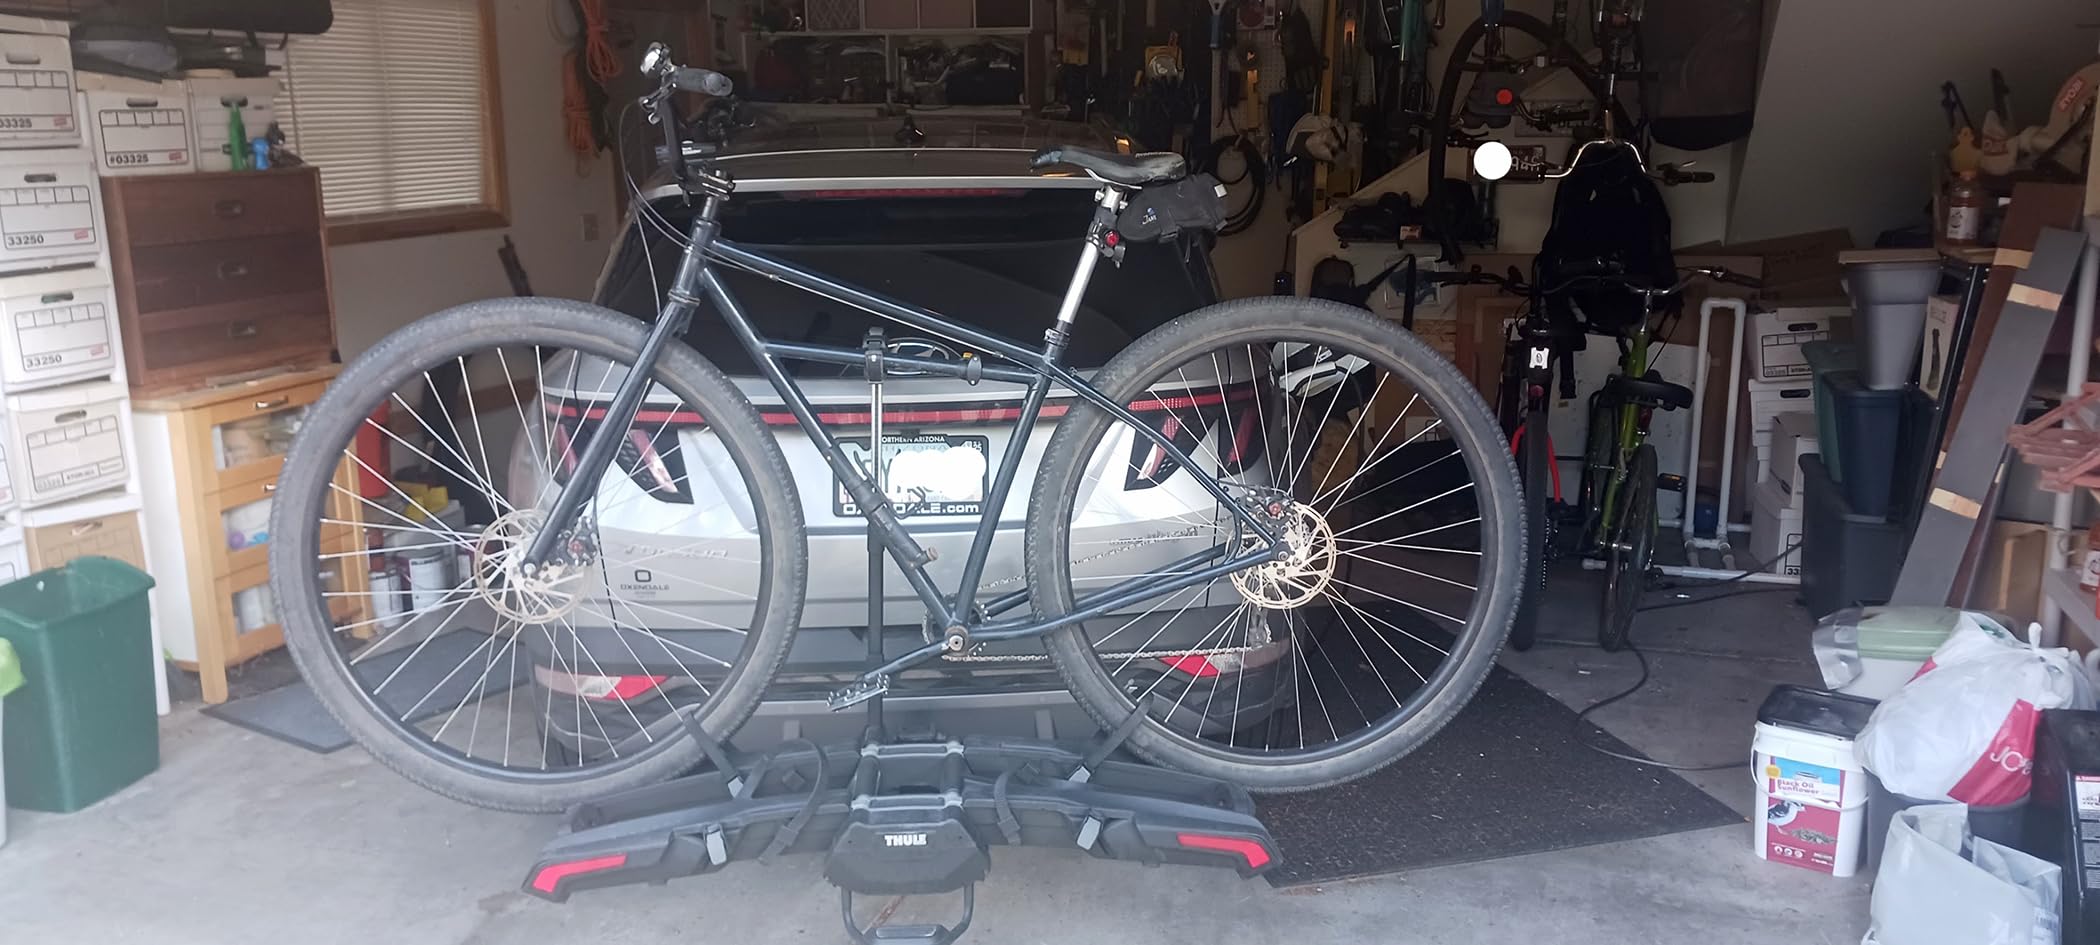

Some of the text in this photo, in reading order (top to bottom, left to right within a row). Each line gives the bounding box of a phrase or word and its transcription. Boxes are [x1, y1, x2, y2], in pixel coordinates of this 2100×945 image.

[109, 154, 149, 164] #03325
[7, 236, 44, 246] 33250
[26, 354, 62, 368] 33250
[914, 435, 945, 443] ARIZONA
[1777, 779, 1800, 788] Black
[1777, 785, 1820, 794] Sunflower
[884, 834, 927, 846] THULE
